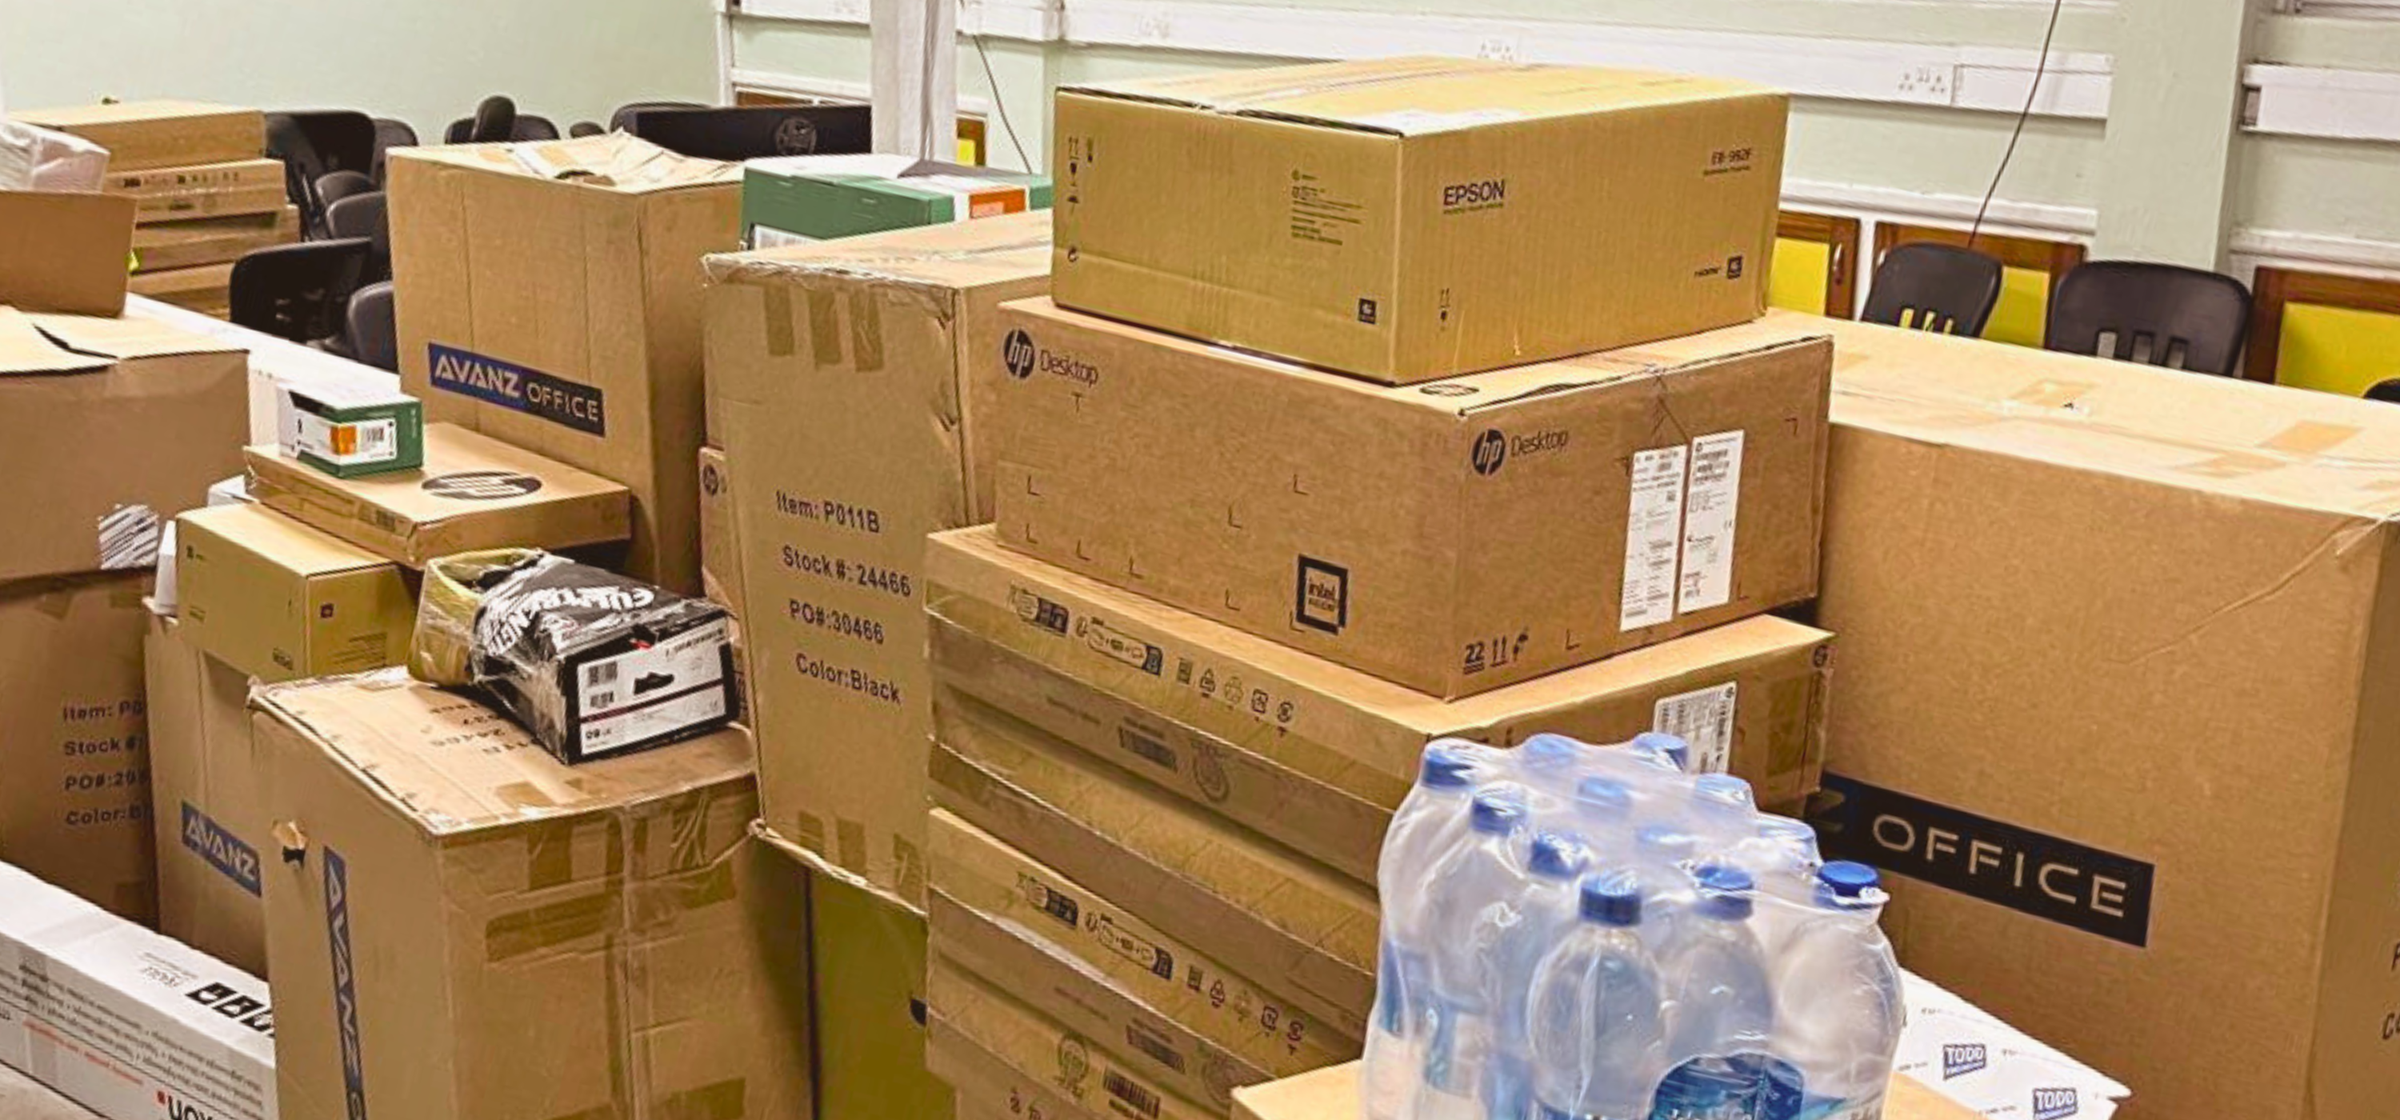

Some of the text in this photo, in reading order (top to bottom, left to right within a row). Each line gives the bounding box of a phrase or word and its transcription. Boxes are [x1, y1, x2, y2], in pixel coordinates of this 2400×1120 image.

[1444, 179, 1505, 206] EPSON
[1004, 328, 1099, 388] hp Desktop
[435, 354, 599, 422] AVANZ OFFICE
[1472, 429, 1568, 476] hp Desktop
[776, 490, 880, 533] Item: P011B
[783, 544, 832, 580] Stock
[857, 563, 912, 598] 24466
[789, 599, 884, 645] PO#:30466
[796, 653, 901, 705] Color:Black
[63, 704, 113, 721] Item:
[64, 737, 121, 756] Stock
[186, 813, 257, 880] AVANZ
[1873, 814, 2126, 917] OFFICE
[328, 861, 359, 1079] AVANZ
